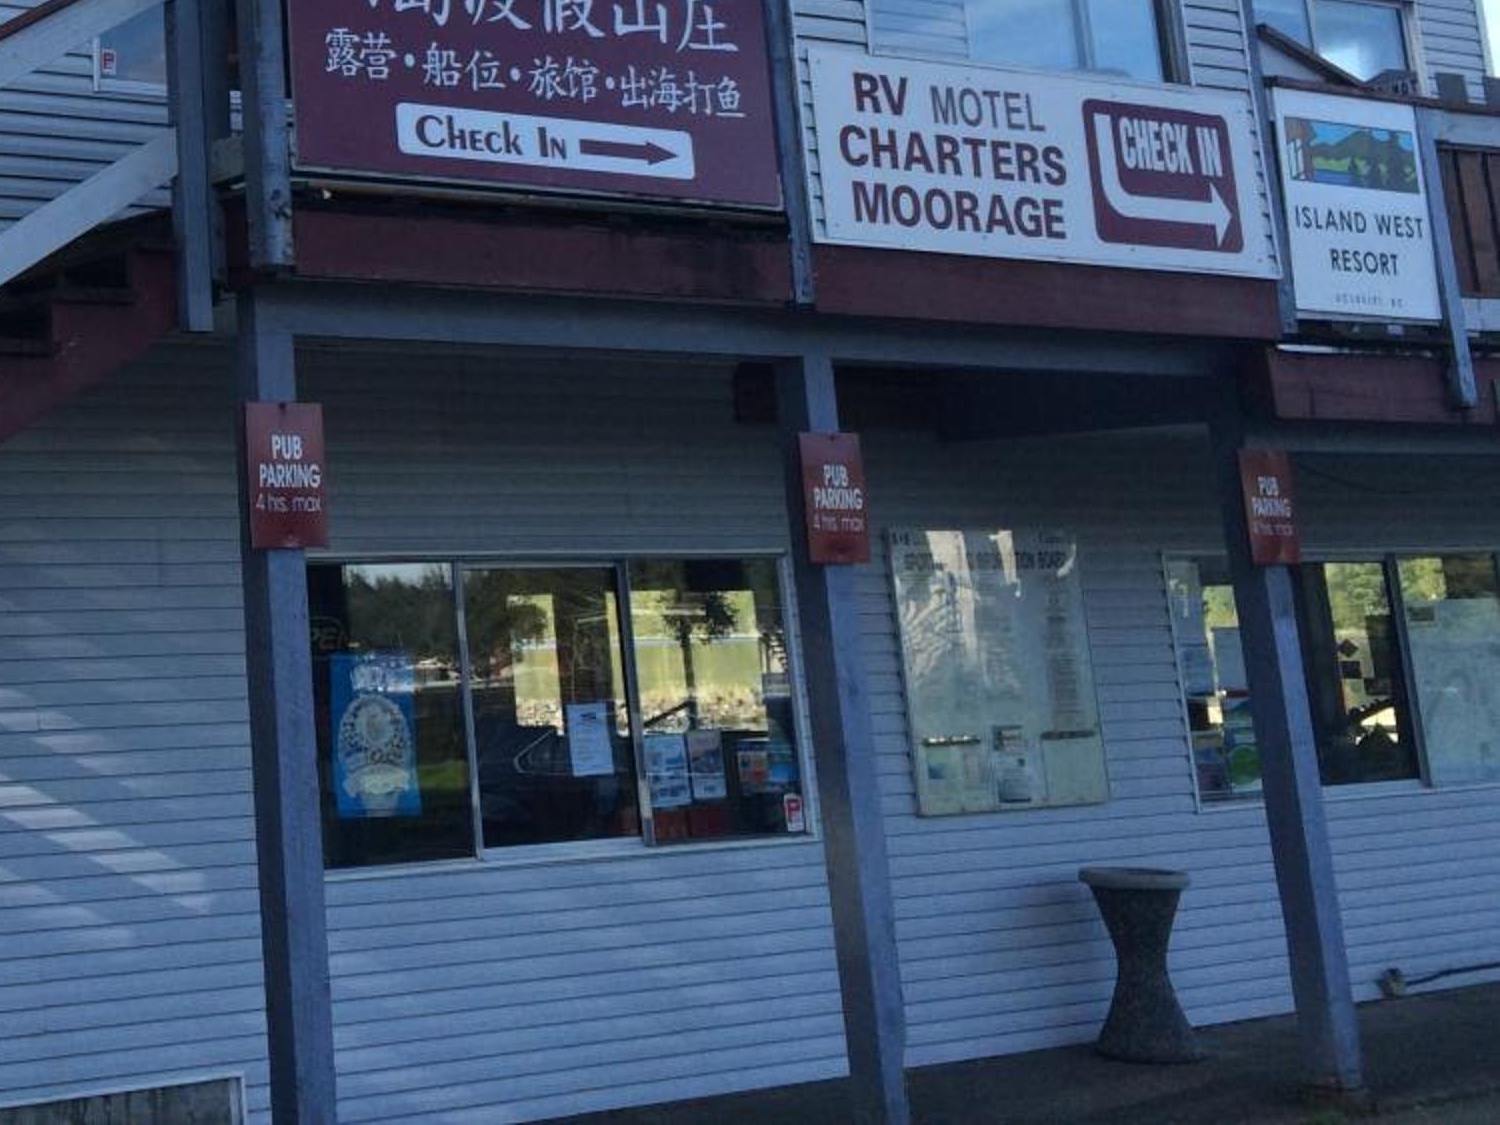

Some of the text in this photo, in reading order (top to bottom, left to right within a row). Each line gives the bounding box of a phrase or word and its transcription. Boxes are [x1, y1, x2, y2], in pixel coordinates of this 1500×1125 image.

[852, 71, 1046, 132] RV MOTEL
[838, 124, 1068, 187] CHARTERS
[1118, 115, 1224, 178] CHECK IN
[851, 180, 1068, 240] MOORAGE
[1294, 204, 1423, 239] ISLAND WEST
[1329, 248, 1398, 276] RESORT
[271, 434, 303, 460] PUB
[259, 463, 322, 489] PARKING
[823, 464, 849, 488] PUB
[813, 487, 864, 510] PARKING
